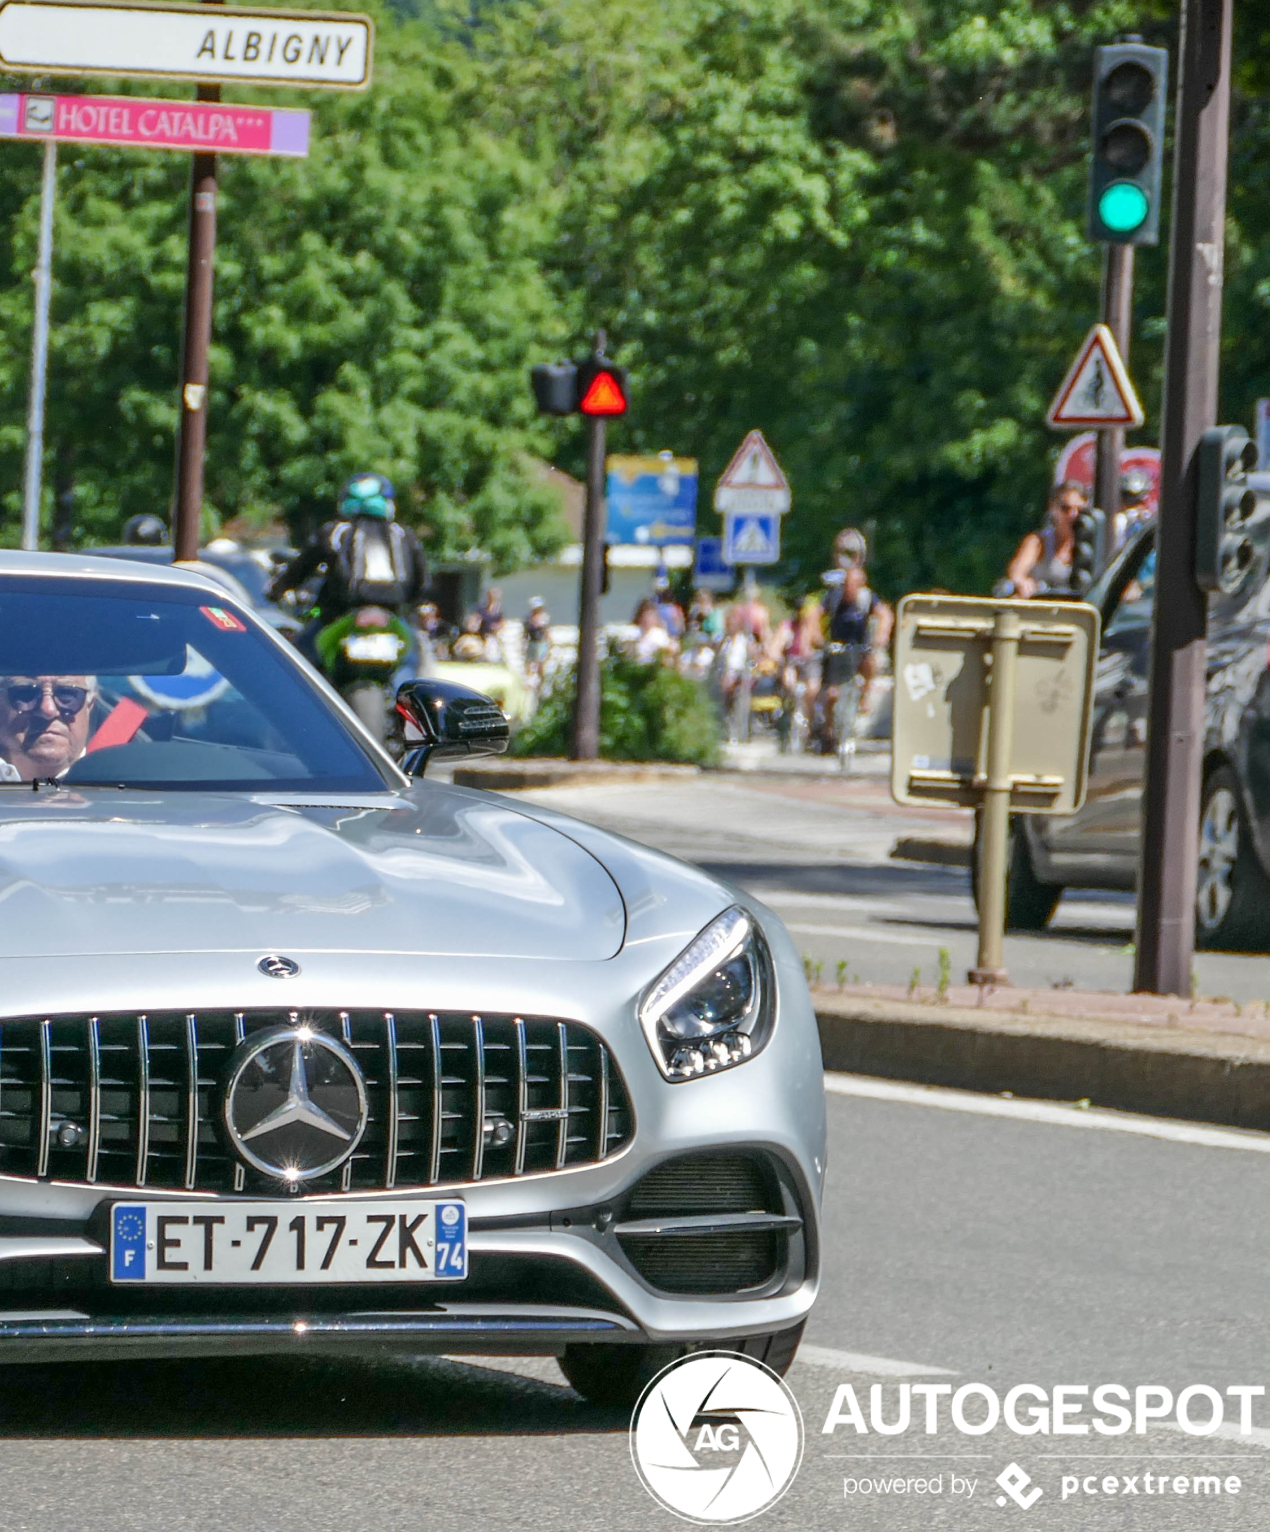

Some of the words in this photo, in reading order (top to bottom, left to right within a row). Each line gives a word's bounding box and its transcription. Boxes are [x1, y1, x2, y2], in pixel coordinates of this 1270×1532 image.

[197, 29, 352, 66] ALBIGNY
[59, 103, 132, 136] HOTEL
[125, 1251, 136, 1267] F
[156, 1214, 428, 1271] ET-717-ZK
[437, 1242, 463, 1270] 74
